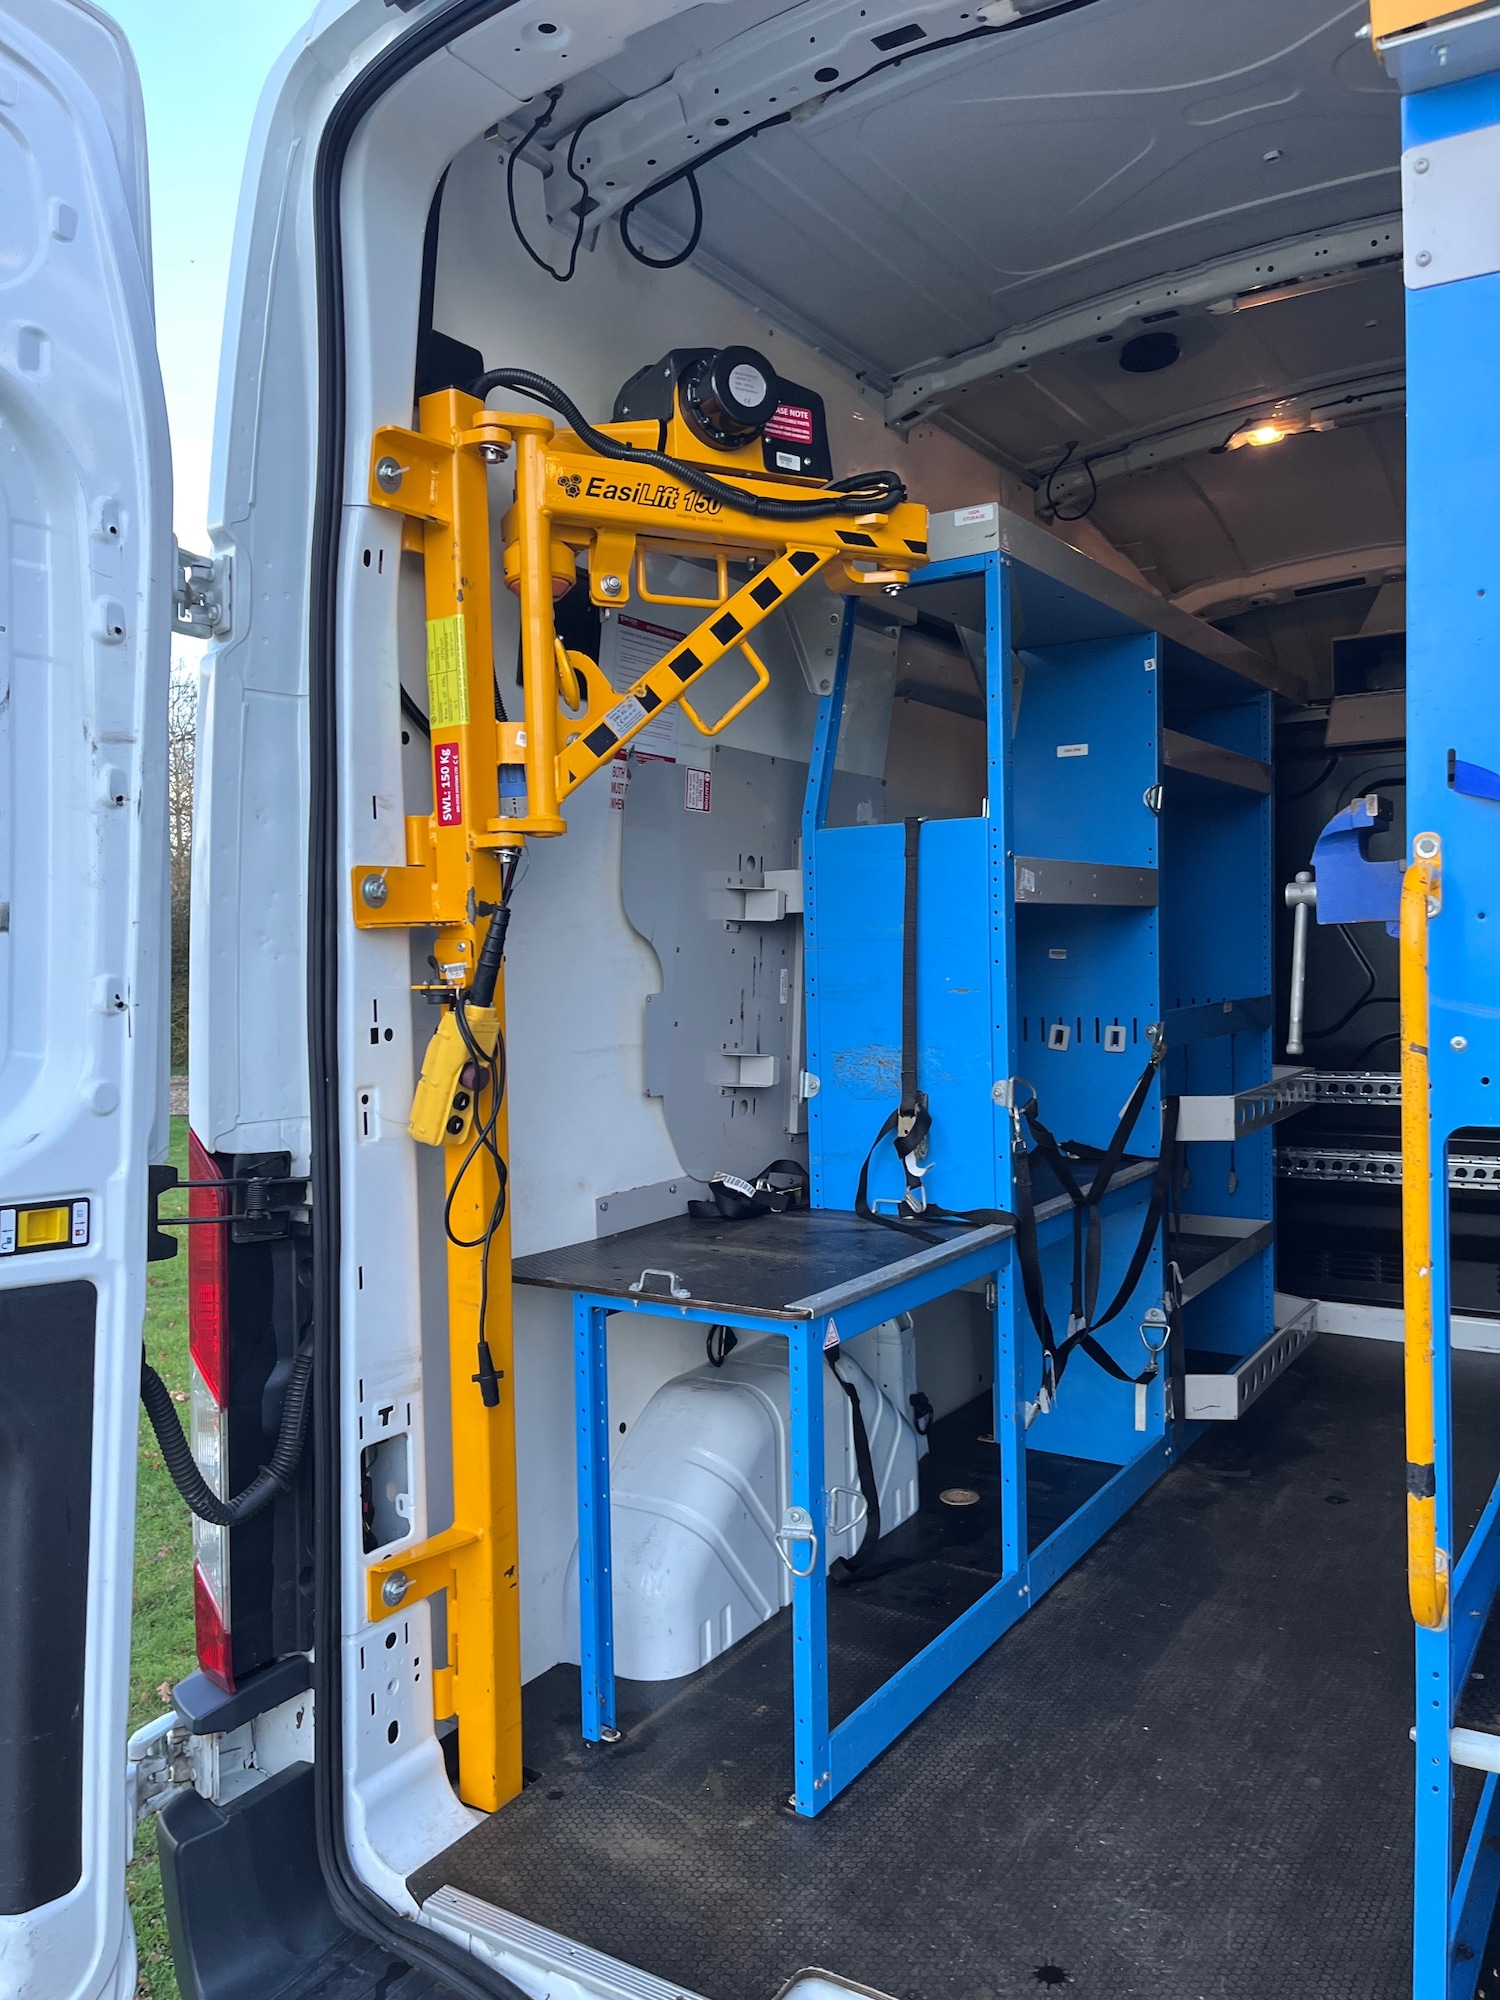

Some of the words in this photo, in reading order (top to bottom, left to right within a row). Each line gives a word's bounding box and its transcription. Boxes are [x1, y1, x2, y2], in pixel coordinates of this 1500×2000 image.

[775, 407, 789, 416] ASE
[789, 409, 809, 419] NOTE
[585, 476, 679, 509] EasiLift
[684, 489, 723, 515] 150
[1146, 661, 1153, 669] 3
[440, 748, 451, 764] Kg
[440, 766, 451, 788] 150
[612, 765, 626, 779] BOTH
[610, 781, 624, 795] MUST
[441, 791, 452, 821] SWL:
